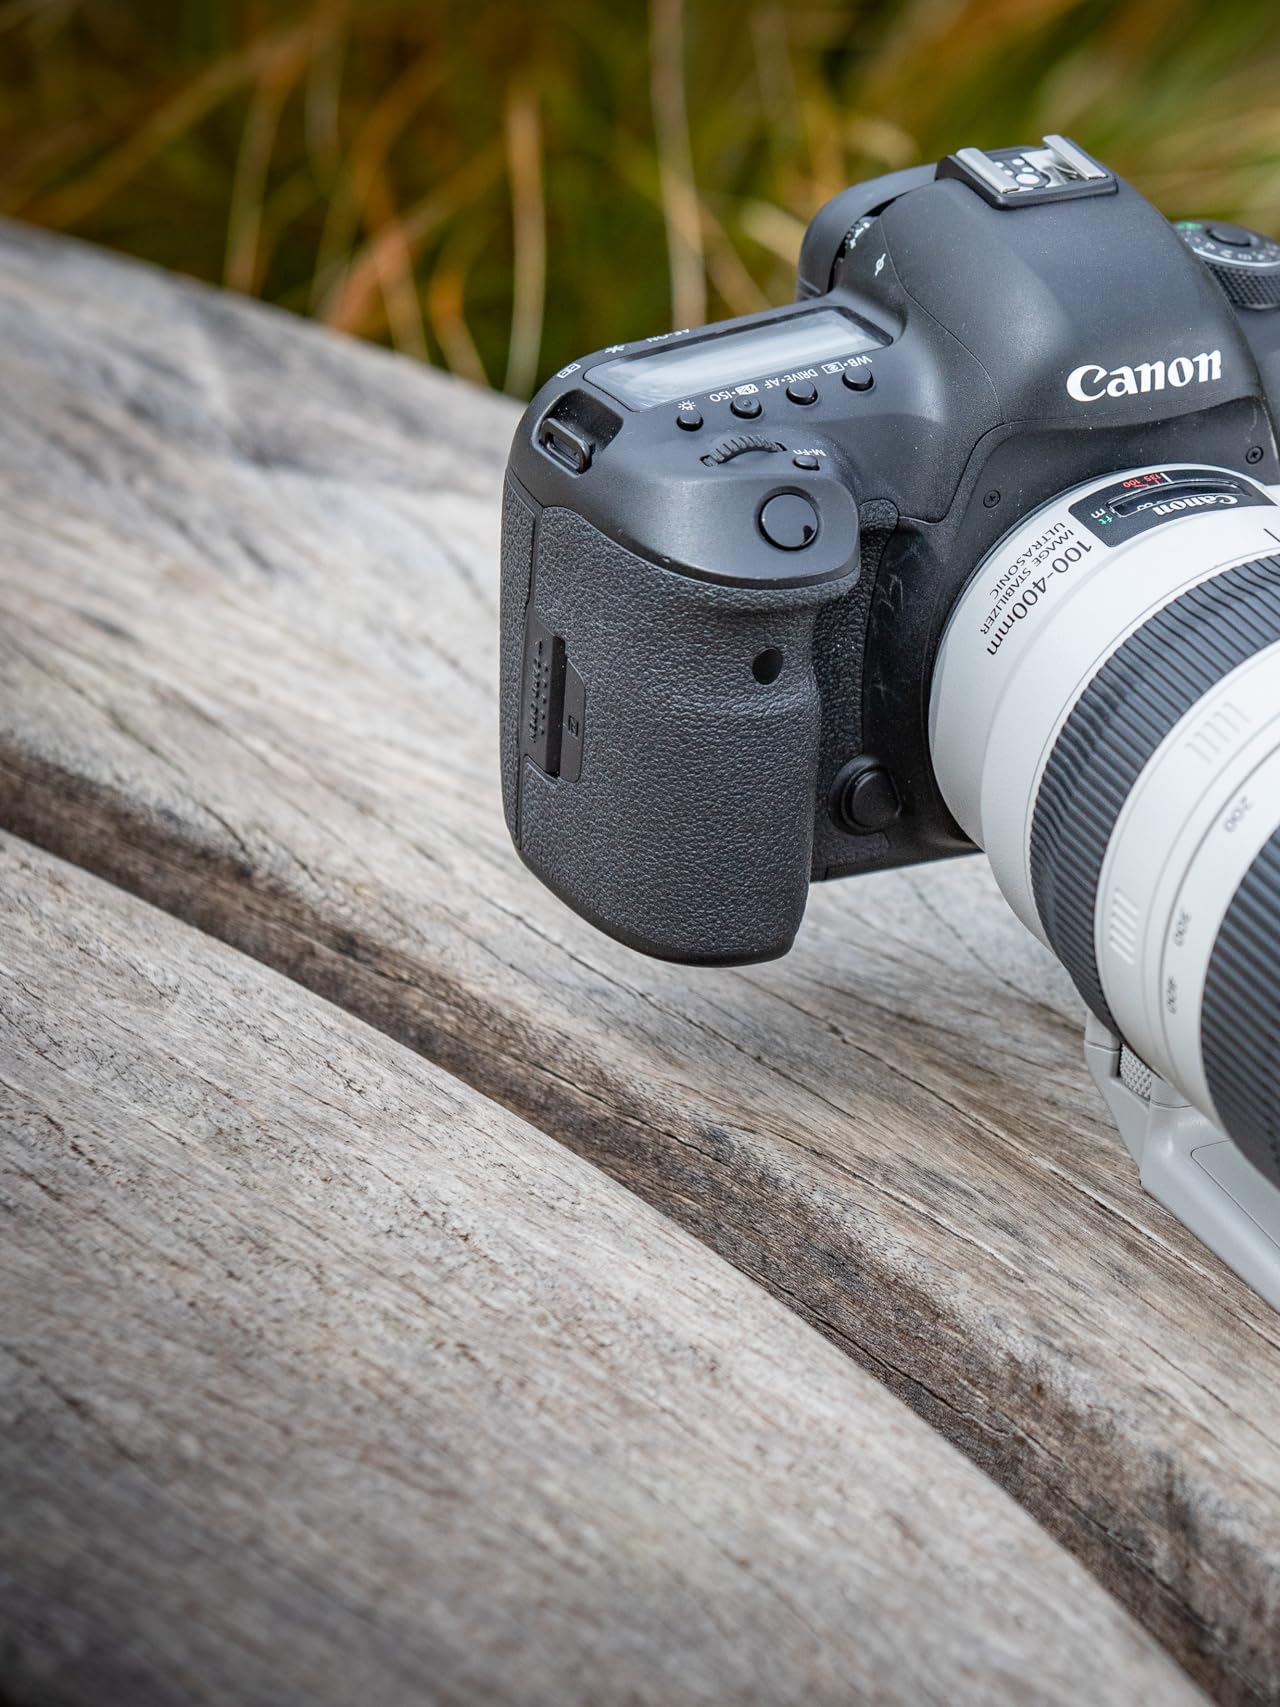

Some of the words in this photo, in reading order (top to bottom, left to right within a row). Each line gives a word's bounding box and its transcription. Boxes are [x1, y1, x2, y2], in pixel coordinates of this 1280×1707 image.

[1066, 350, 1222, 402] Canon
[1122, 478, 1141, 488] 100
[1144, 473, 1162, 482] 135
[1091, 508, 1106, 519] m
[1098, 515, 1113, 525] ft
[1152, 494, 1238, 516] Canon
[990, 522, 1066, 600] ULTRASONIC
[1031, 529, 1074, 567] IMAGE
[980, 568, 1031, 635] STABILIZER
[986, 541, 1092, 655] 100-400mm
[1223, 796, 1253, 833] 200
